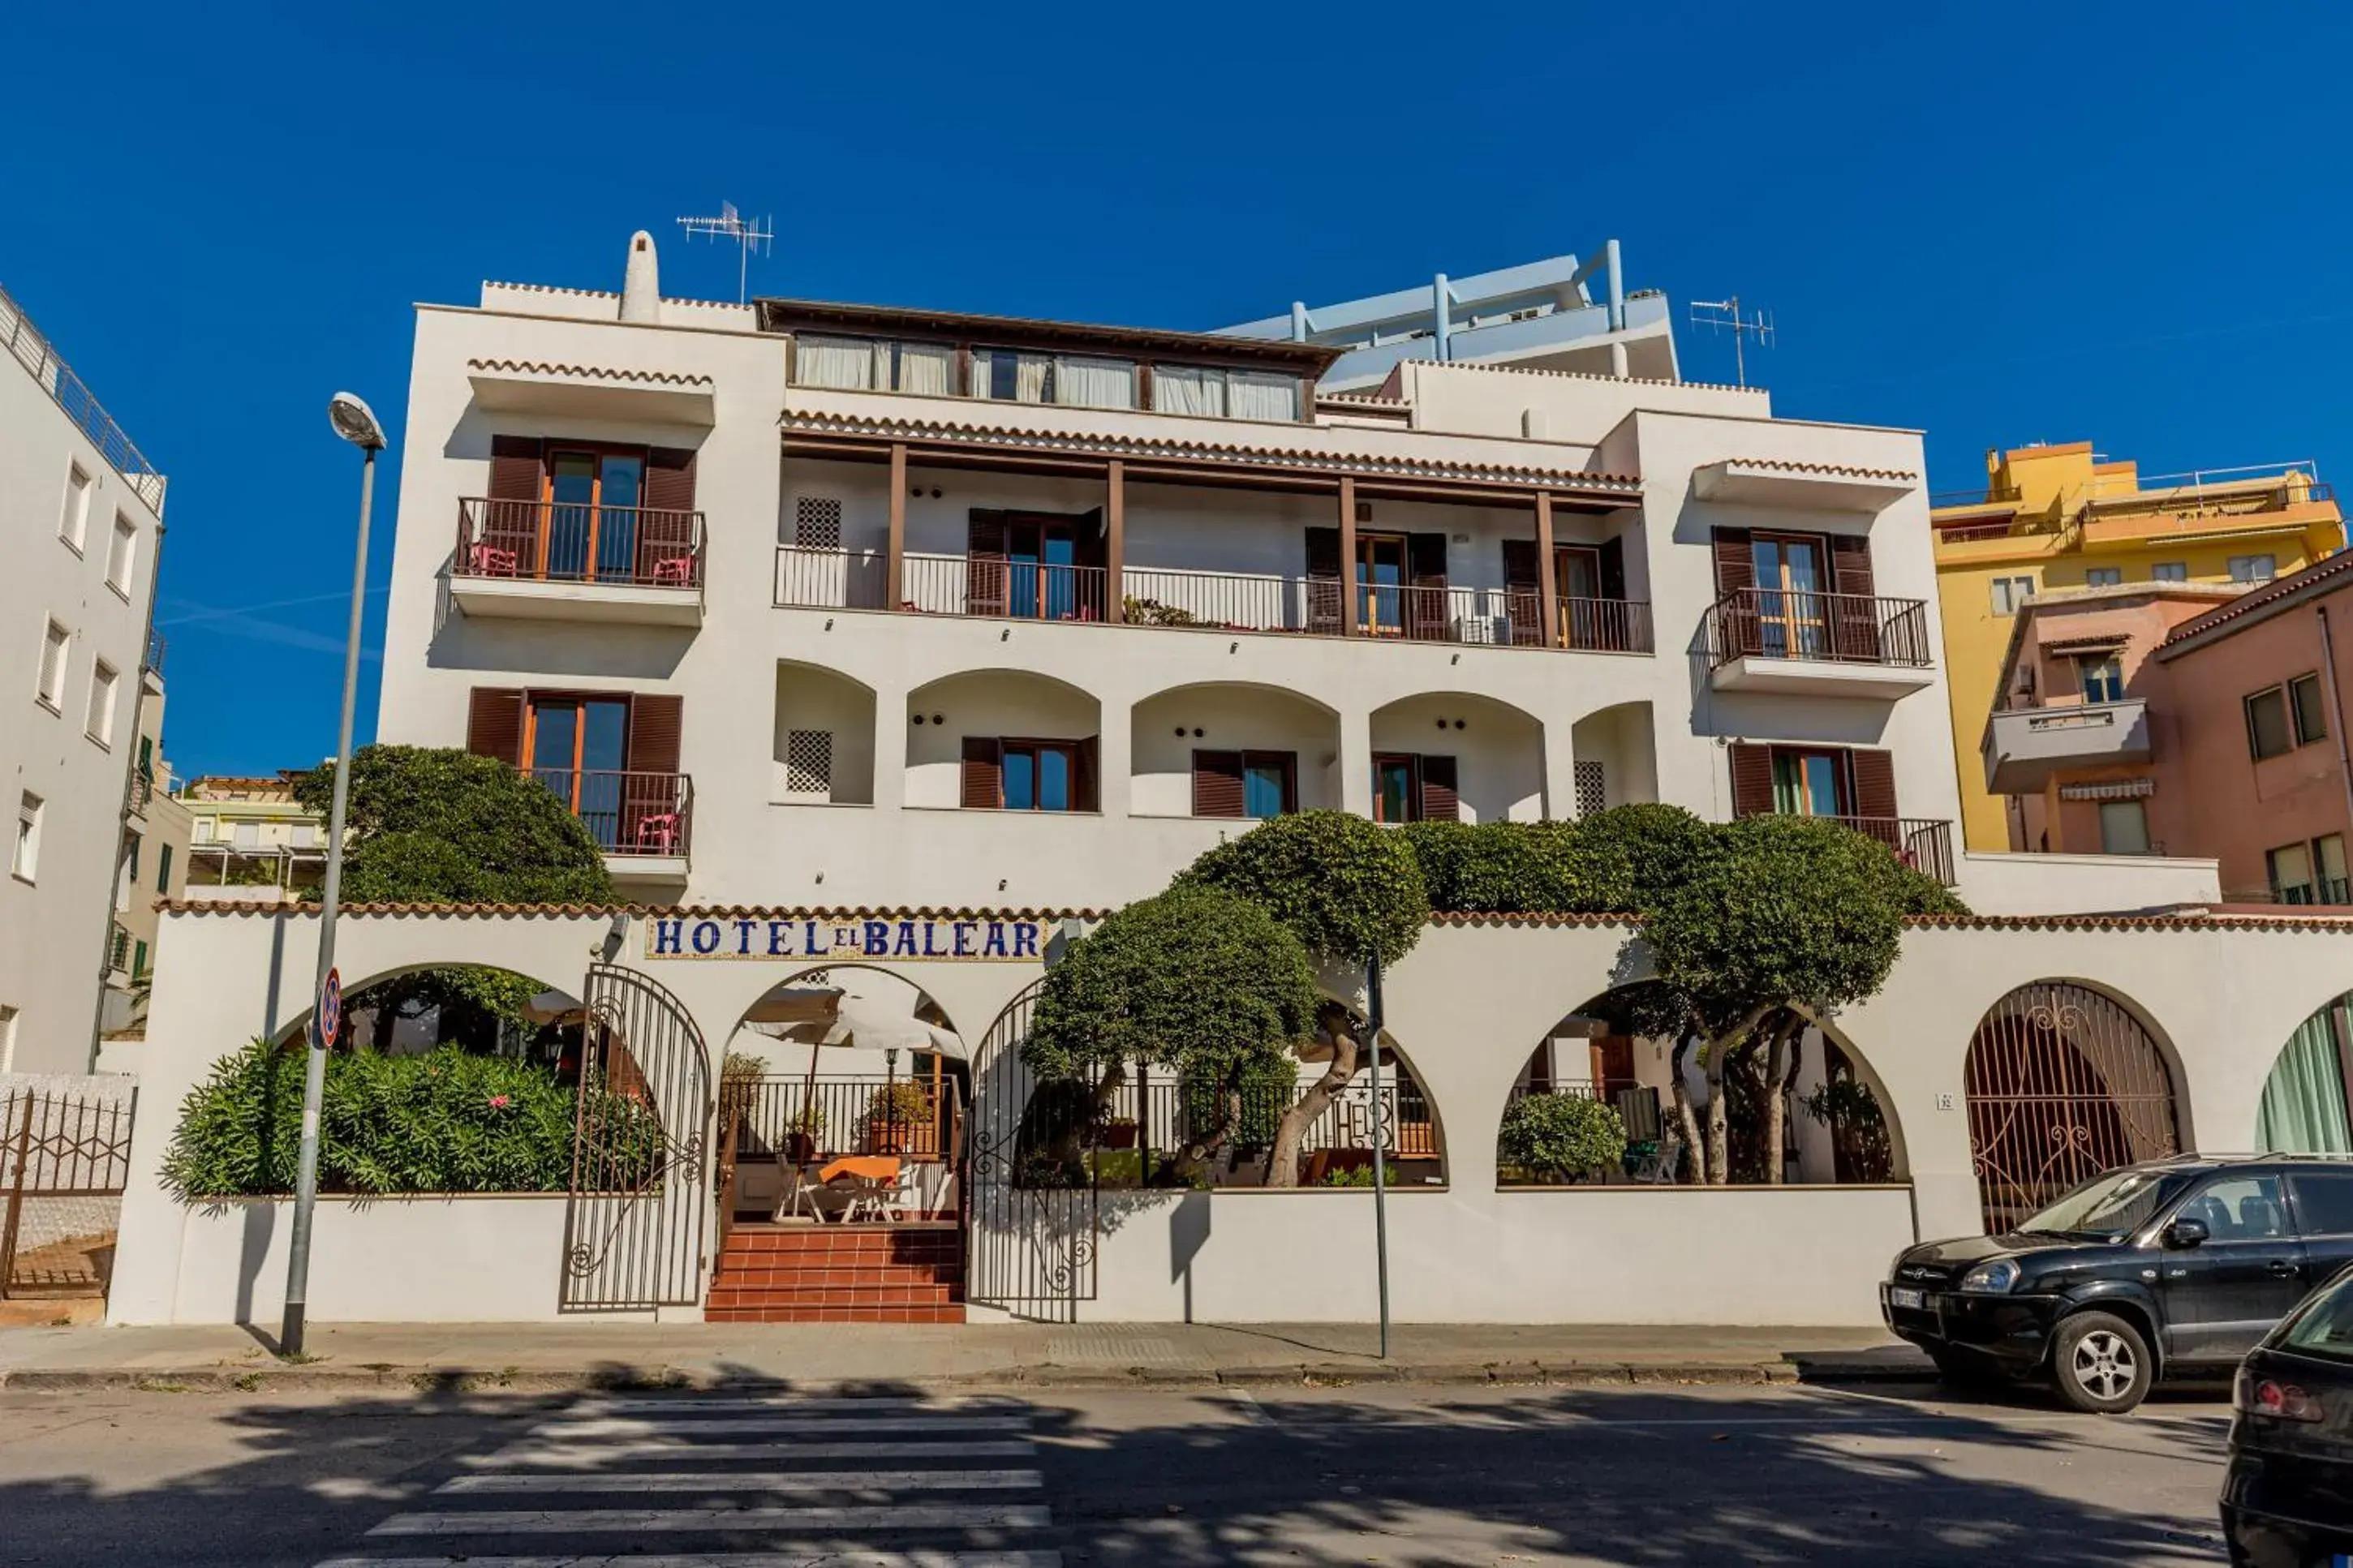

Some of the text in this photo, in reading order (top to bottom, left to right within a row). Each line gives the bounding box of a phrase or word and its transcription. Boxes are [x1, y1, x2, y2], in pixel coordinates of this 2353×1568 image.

[655, 921, 1039, 956] HOTEL EL BALEAR
